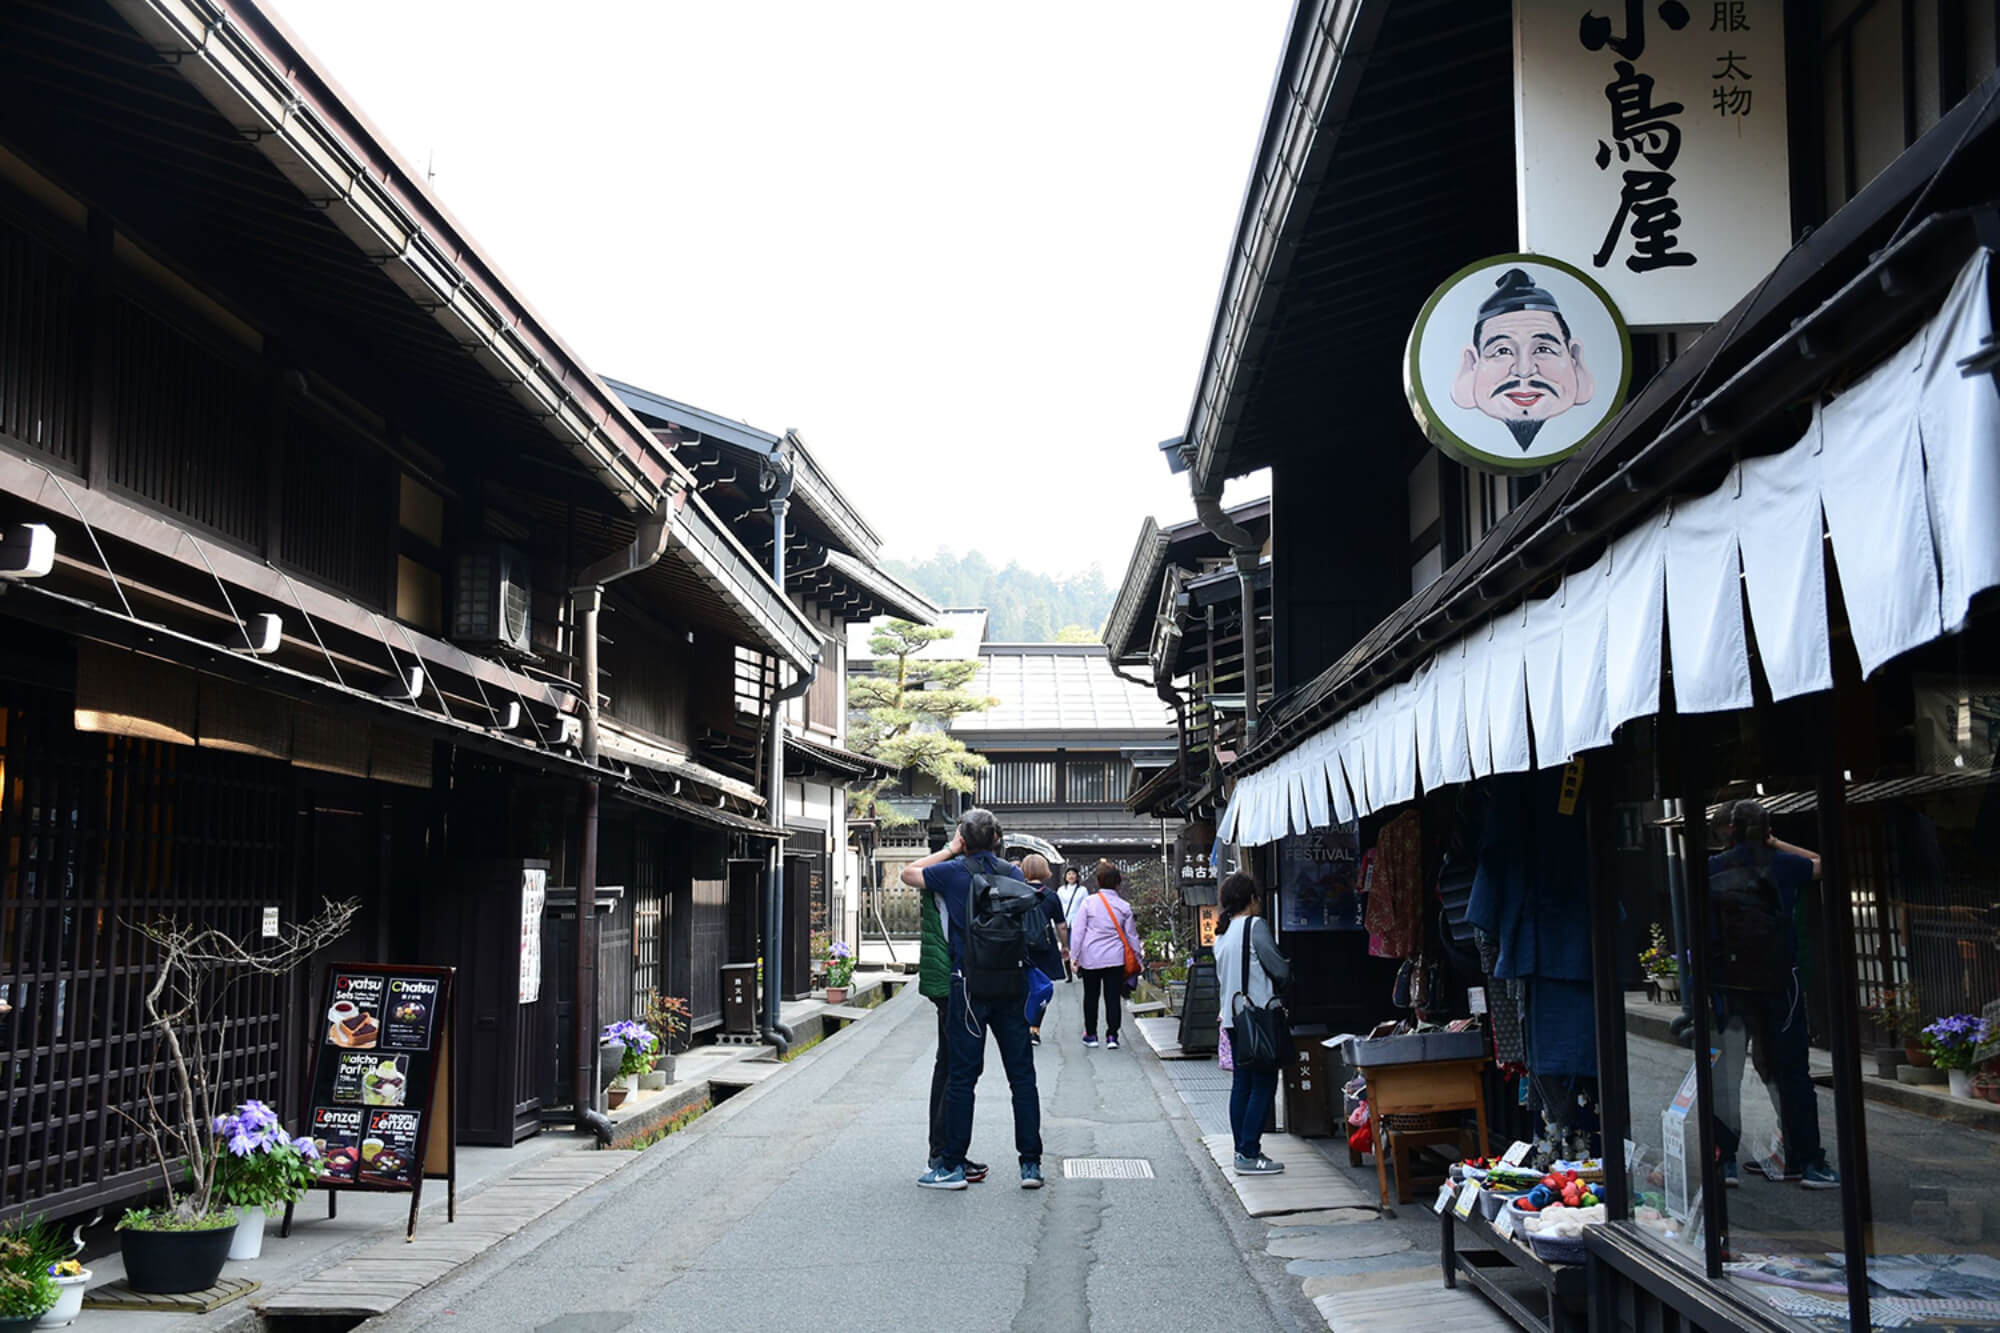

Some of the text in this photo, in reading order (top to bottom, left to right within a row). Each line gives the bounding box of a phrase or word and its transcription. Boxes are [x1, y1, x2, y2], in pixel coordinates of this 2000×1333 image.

[1285, 848, 1355, 862] FESTIVAL
[337, 976, 382, 992] Oyatsu
[391, 981, 435, 994] Chatsu
[342, 1055, 379, 1065] Matcha
[316, 1109, 362, 1123] Zenzai
[381, 1112, 414, 1120] Cream
[371, 1117, 417, 1130] Zenzai
